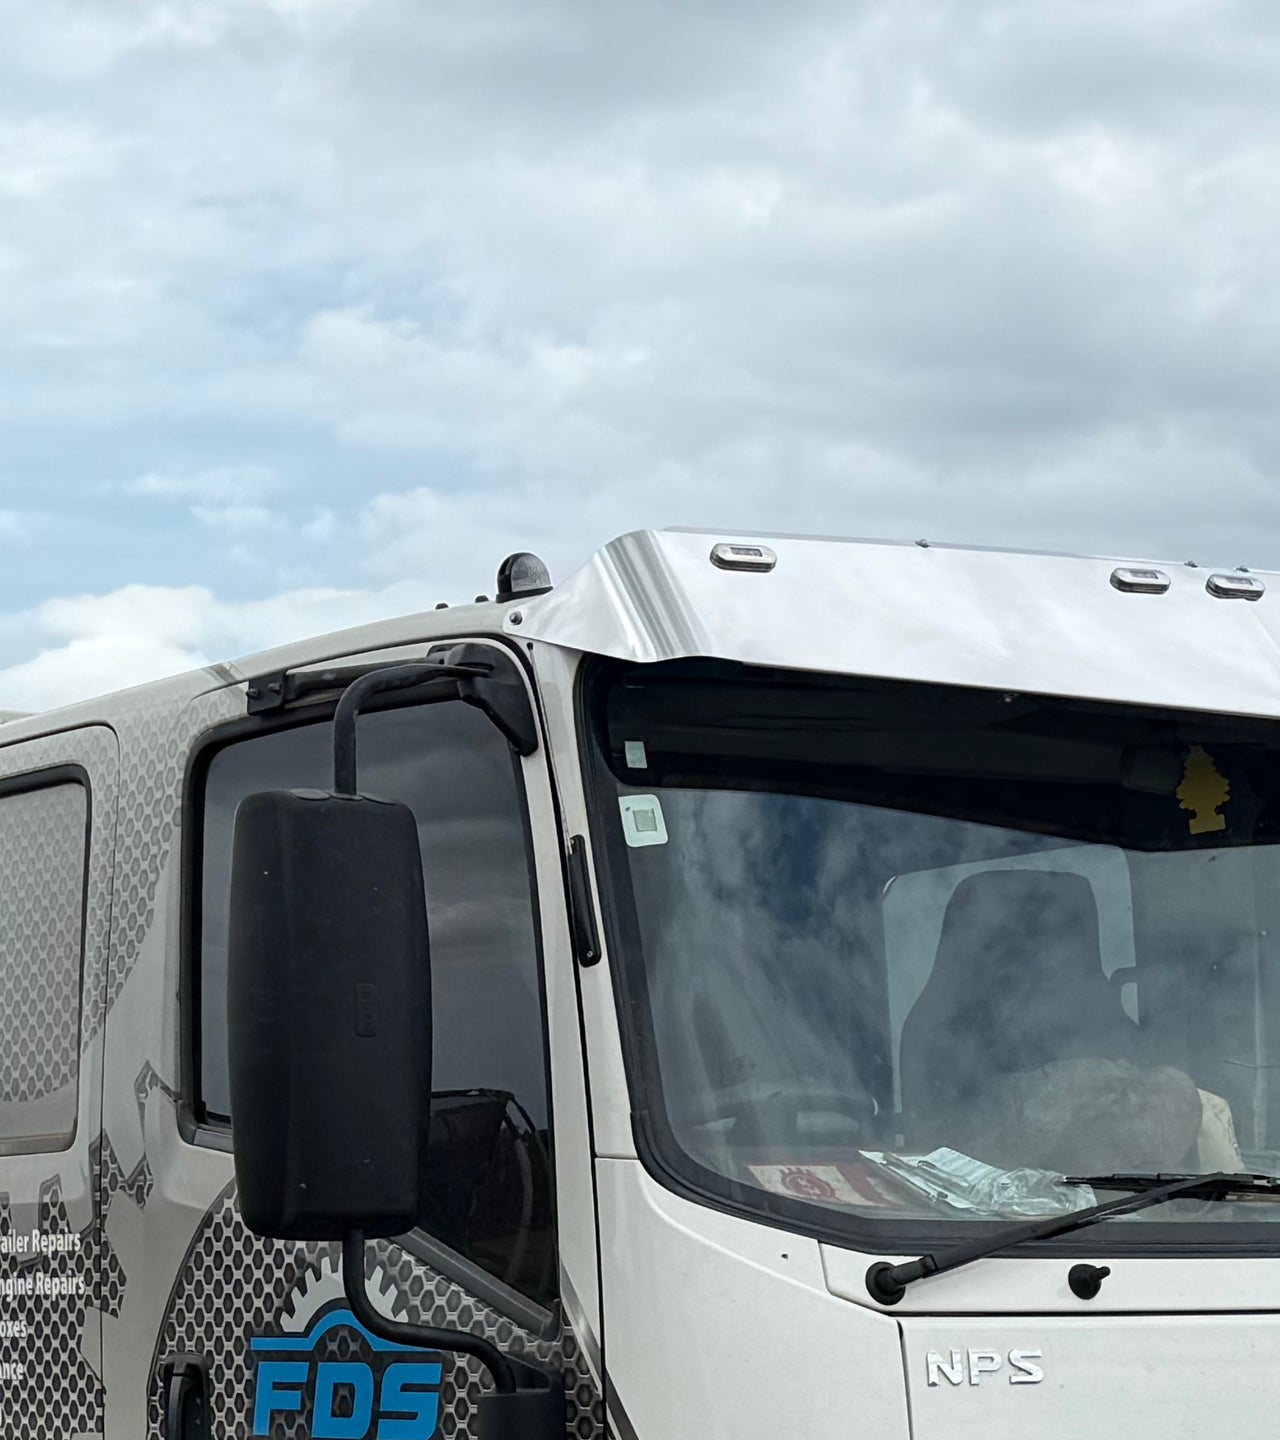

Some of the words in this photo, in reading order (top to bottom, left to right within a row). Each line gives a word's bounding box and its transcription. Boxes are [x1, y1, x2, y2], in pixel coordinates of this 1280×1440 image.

[32, 1227, 81, 1258] Repairs
[35, 1270, 85, 1301] Repairs
[926, 1348, 1045, 1387] NPS
